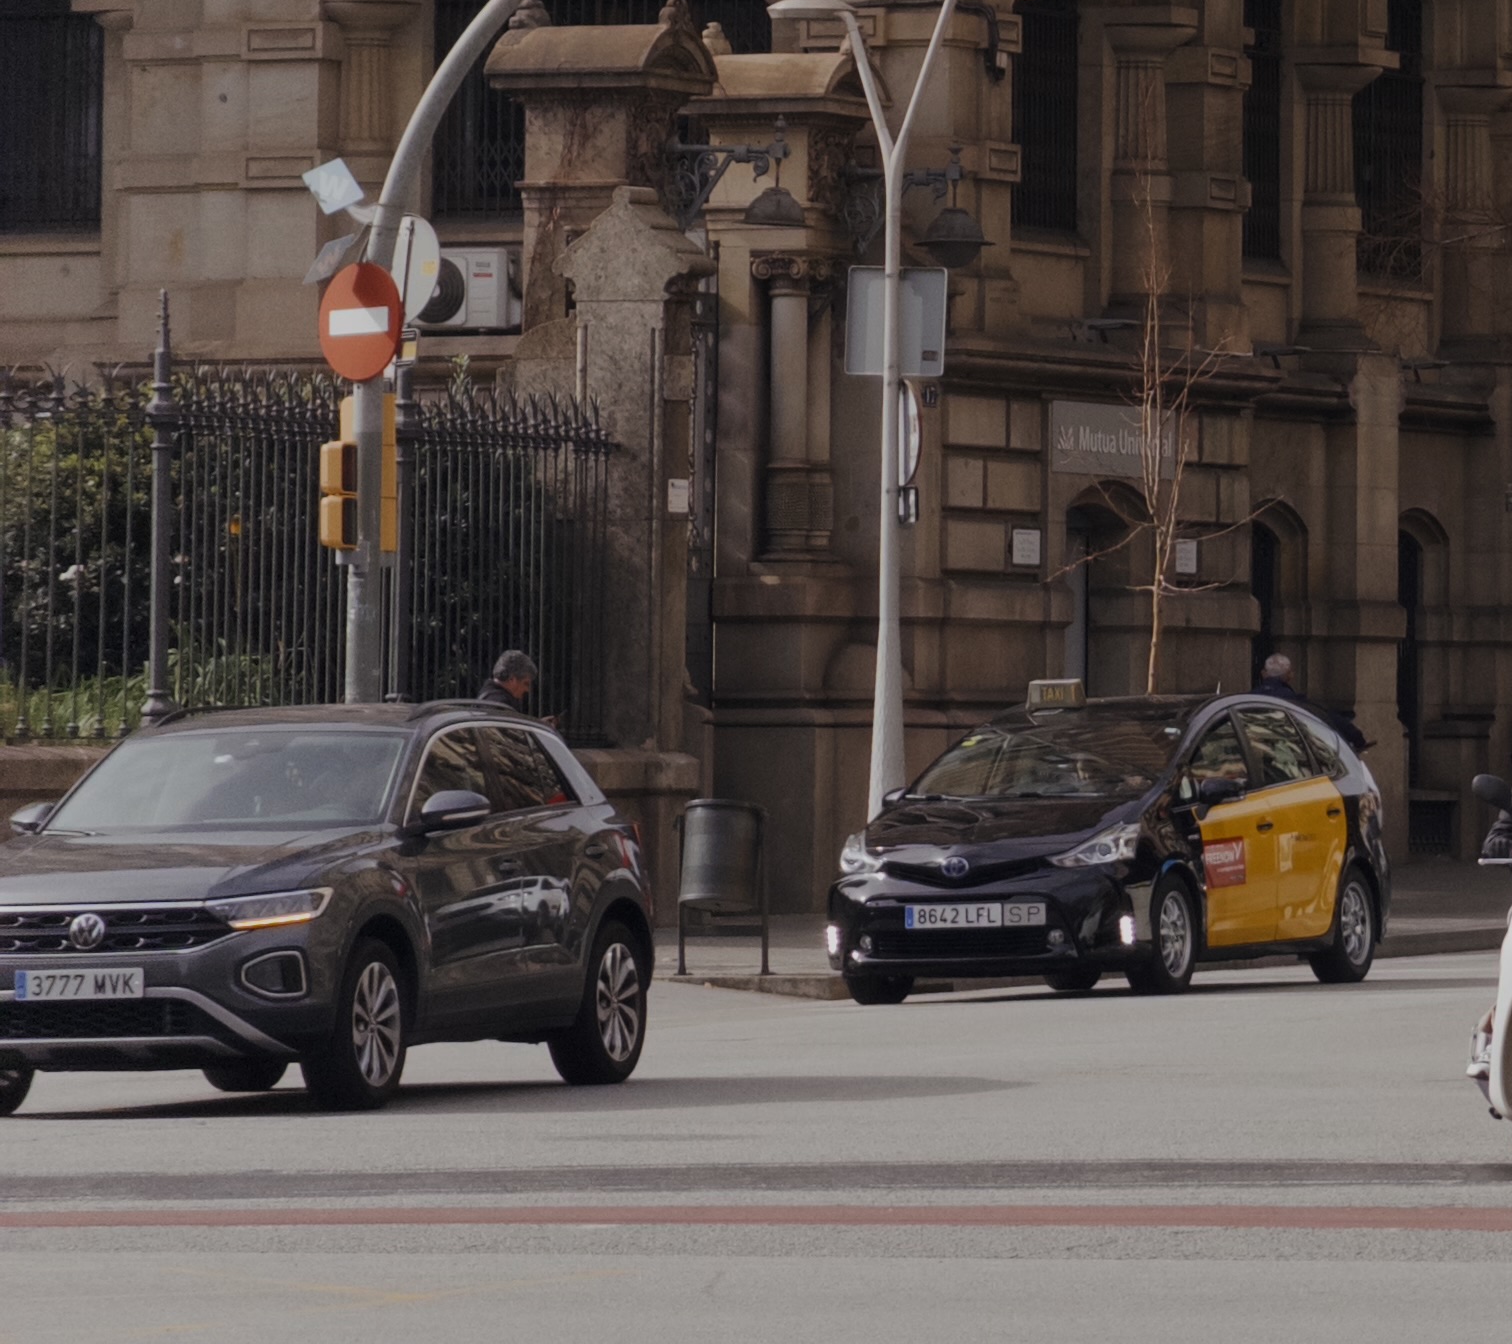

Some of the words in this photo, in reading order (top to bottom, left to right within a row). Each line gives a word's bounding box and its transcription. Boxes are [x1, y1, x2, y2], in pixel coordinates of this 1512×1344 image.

[1079, 425, 1116, 454] Mutua
[1042, 686, 1064, 701] TAXI
[917, 907, 960, 924] 8642
[965, 906, 997, 924] LFL
[31, 974, 86, 996] 3777
[93, 972, 135, 995] MVK
